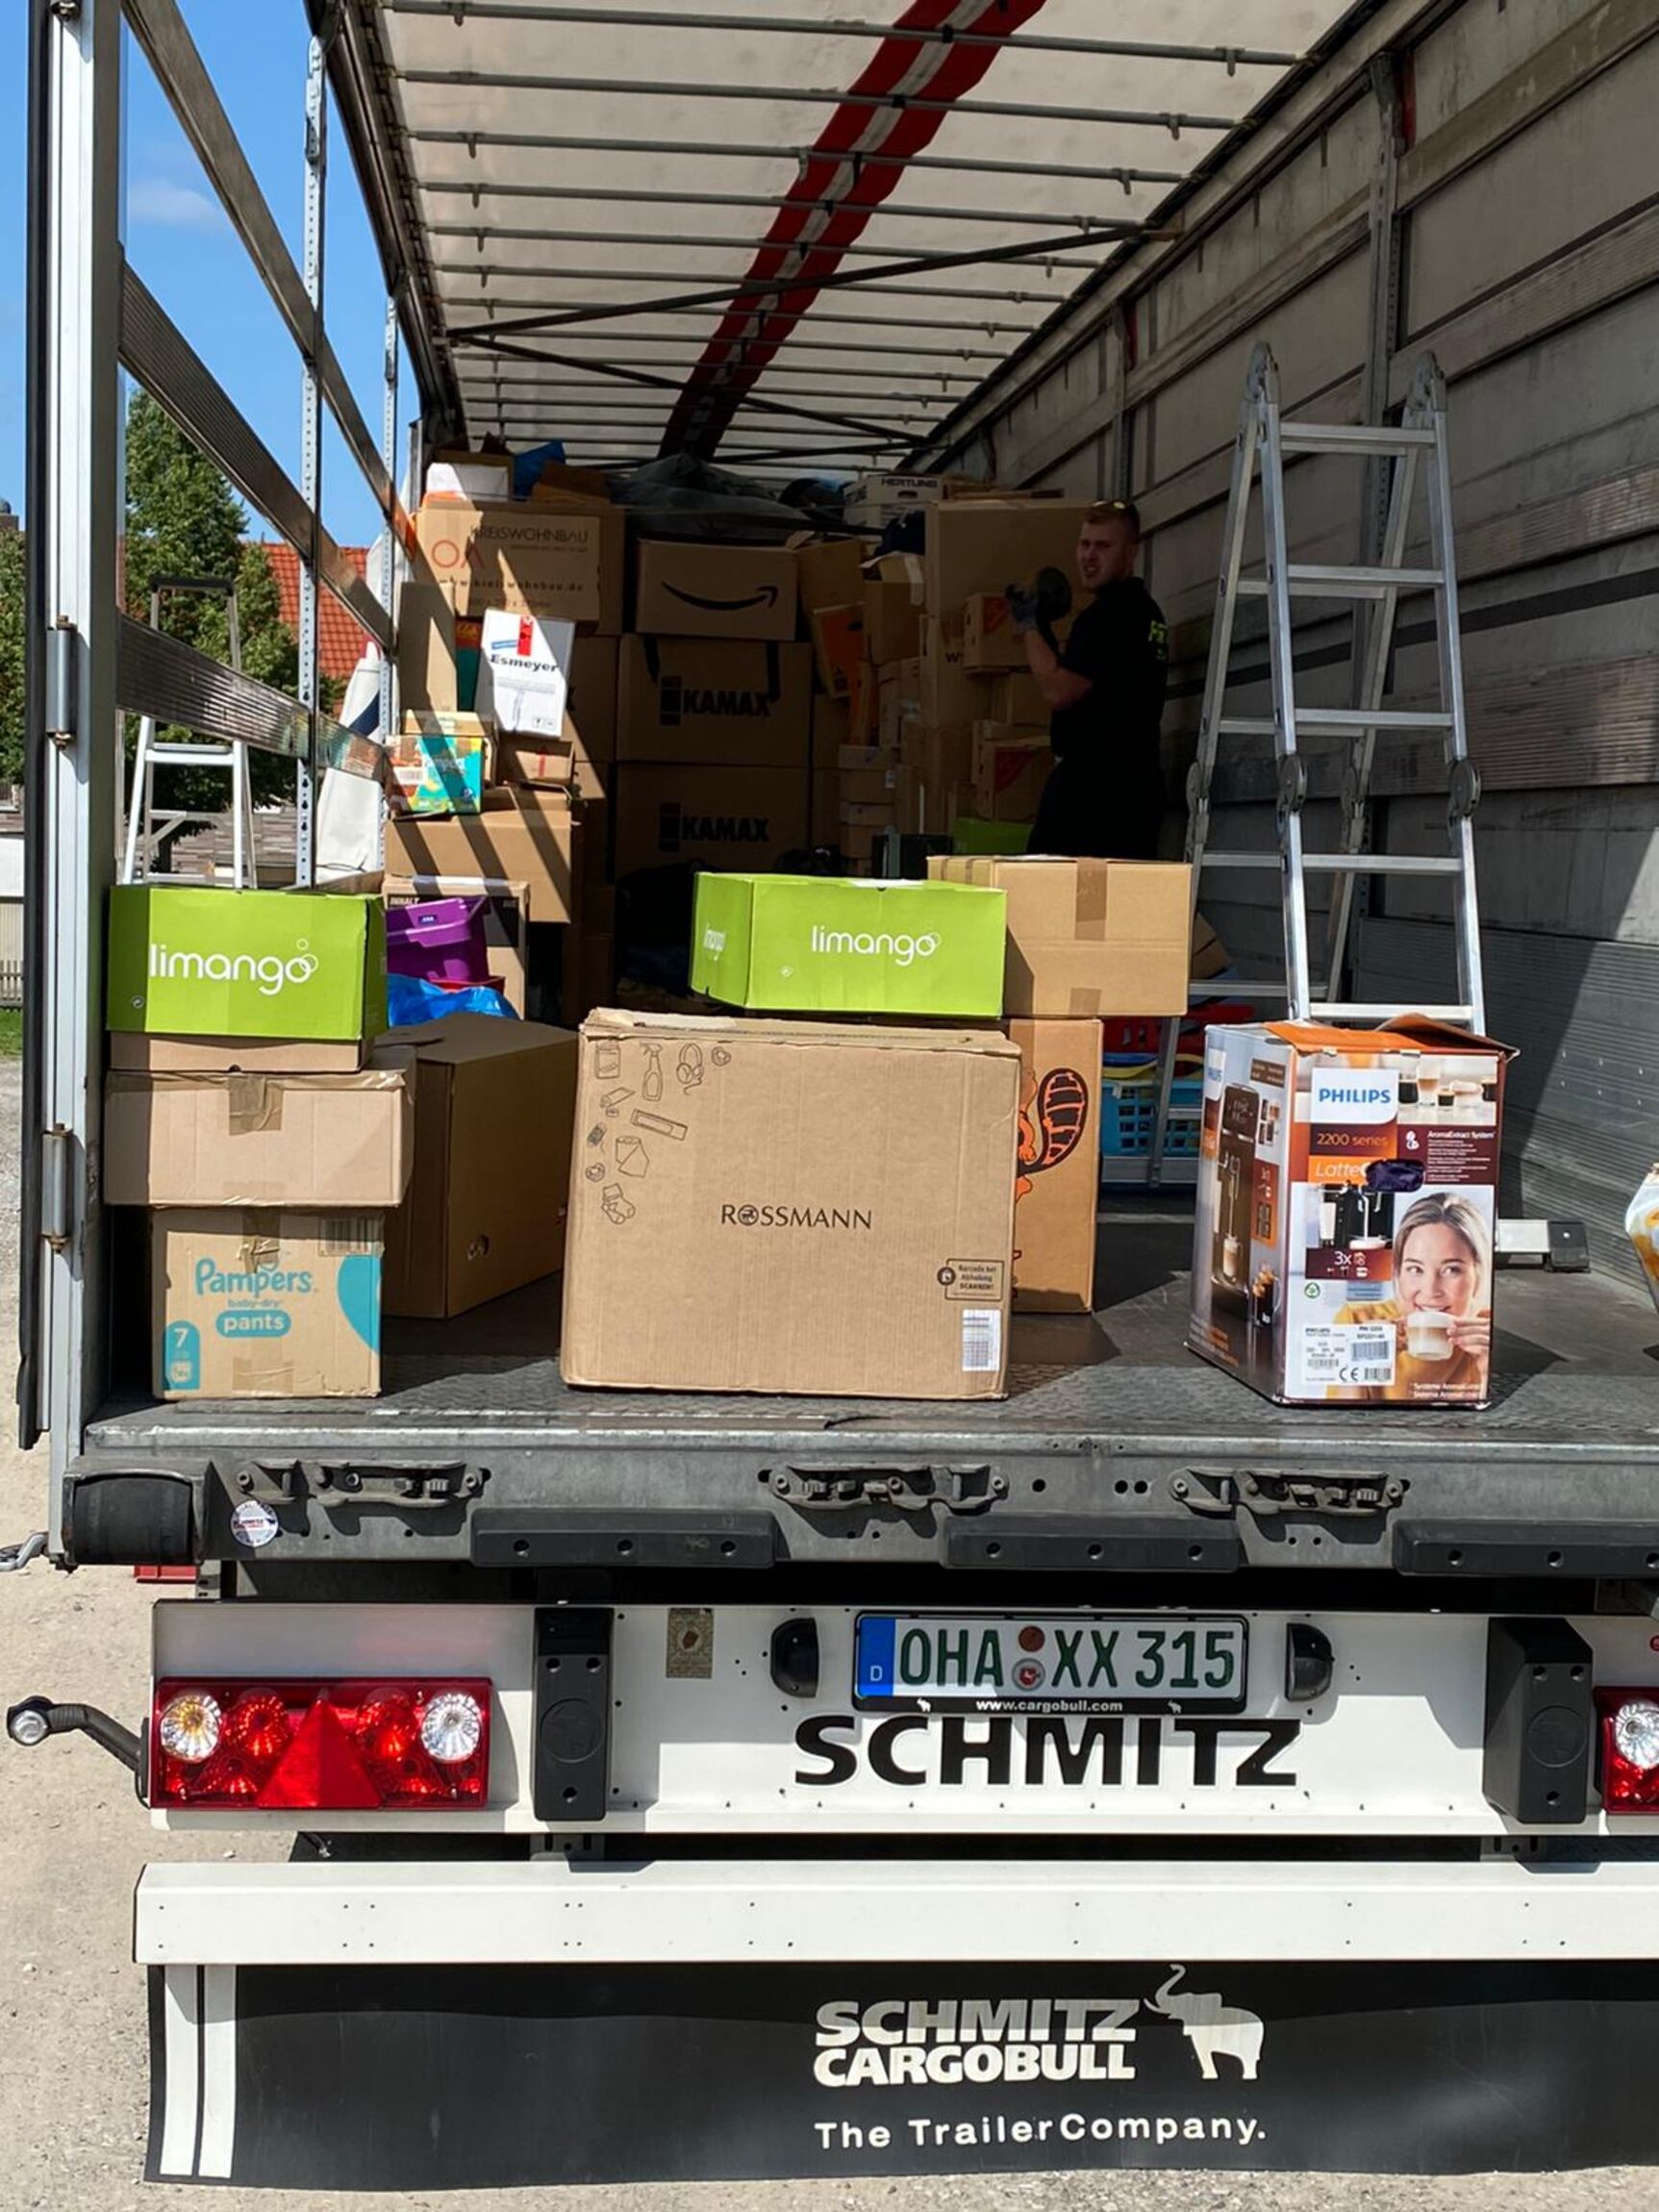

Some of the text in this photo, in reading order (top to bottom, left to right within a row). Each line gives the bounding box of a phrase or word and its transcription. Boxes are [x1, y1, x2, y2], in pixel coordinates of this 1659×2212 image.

[490, 654, 559, 672] Esmeyer
[683, 689, 770, 717] KAMAX
[681, 817, 769, 842] KAMAX
[811, 925, 937, 968] limango
[149, 944, 311, 995] limango
[1319, 1088, 1392, 1104] PHILIPS
[1317, 1133, 1389, 1147] 2200 series
[721, 1204, 872, 1230] ROSSMANN
[195, 1257, 314, 1298] Pampers
[228, 1298, 279, 1310] baby-dry
[223, 1312, 286, 1334] pants
[174, 1327, 189, 1347] 7
[869, 1628, 1235, 1689] D OHA XX 315
[975, 1698, 1123, 1713] www.cargobull.com
[794, 1716, 1301, 1786] SCHMITZ
[815, 1998, 1141, 2047] SCHMITZ
[813, 2043, 1137, 2088] CARGOBULL
[814, 2123, 892, 2149] The
